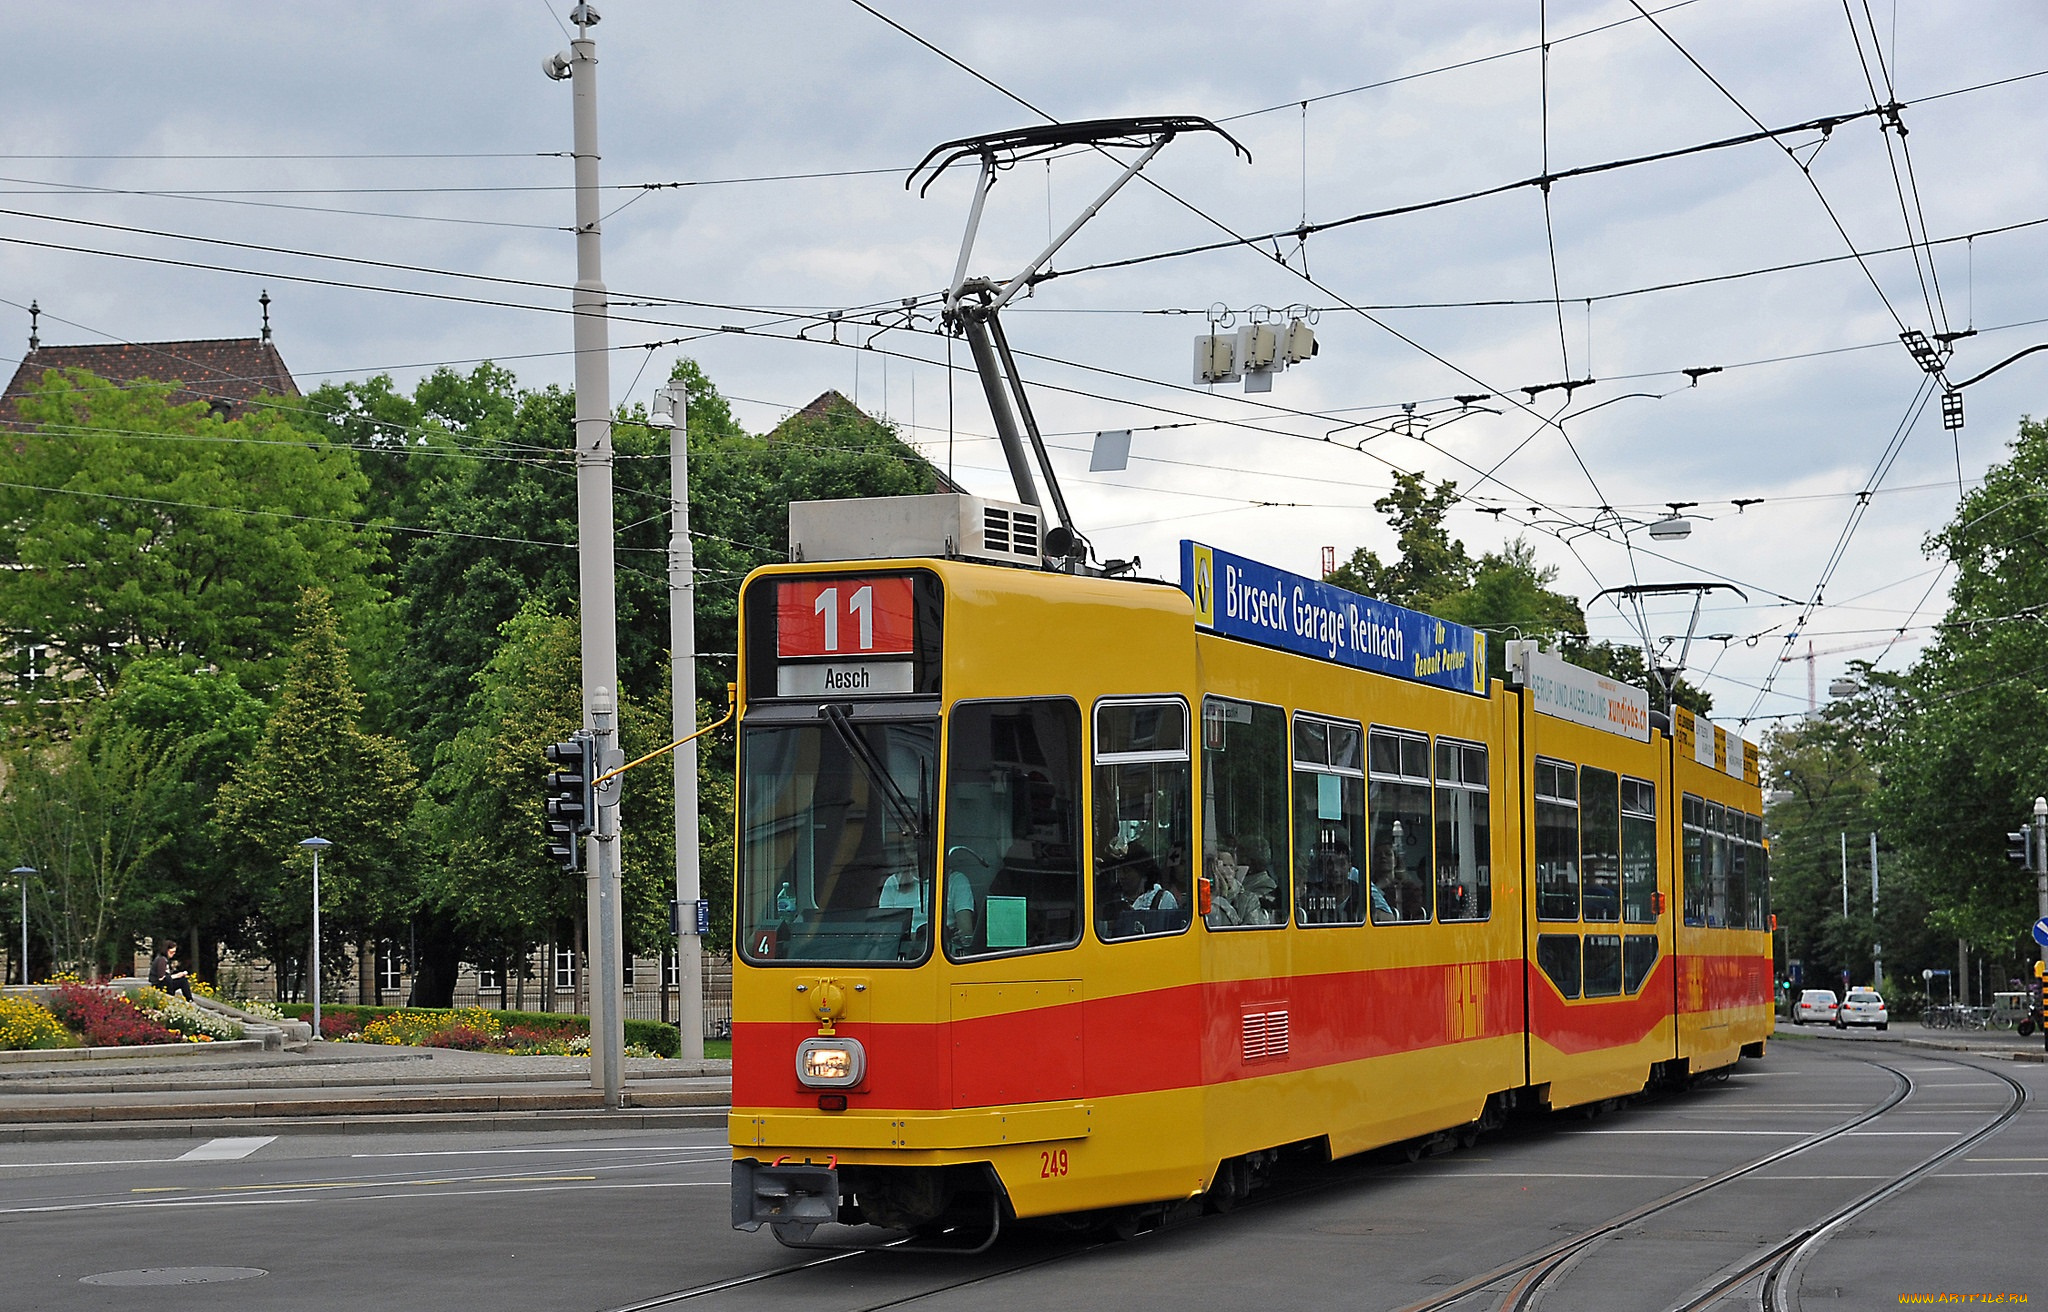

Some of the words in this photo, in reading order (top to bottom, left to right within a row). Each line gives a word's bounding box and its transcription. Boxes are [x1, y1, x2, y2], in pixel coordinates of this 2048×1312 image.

[815, 585, 873, 651] 11
[1226, 564, 1288, 631] Birseck
[1292, 586, 1345, 660] Garage
[1350, 604, 1404, 661] Reinach
[1414, 649, 1441, 678] Renault
[1441, 648, 1466, 672] Partner
[824, 667, 870, 690] Aesch
[1532, 674, 1553, 703] BERUF
[1554, 681, 1567, 708] UND
[1607, 696, 1648, 733] xundjobs.ch
[758, 935, 769, 955] 4
[1040, 1149, 1069, 1178] 249
